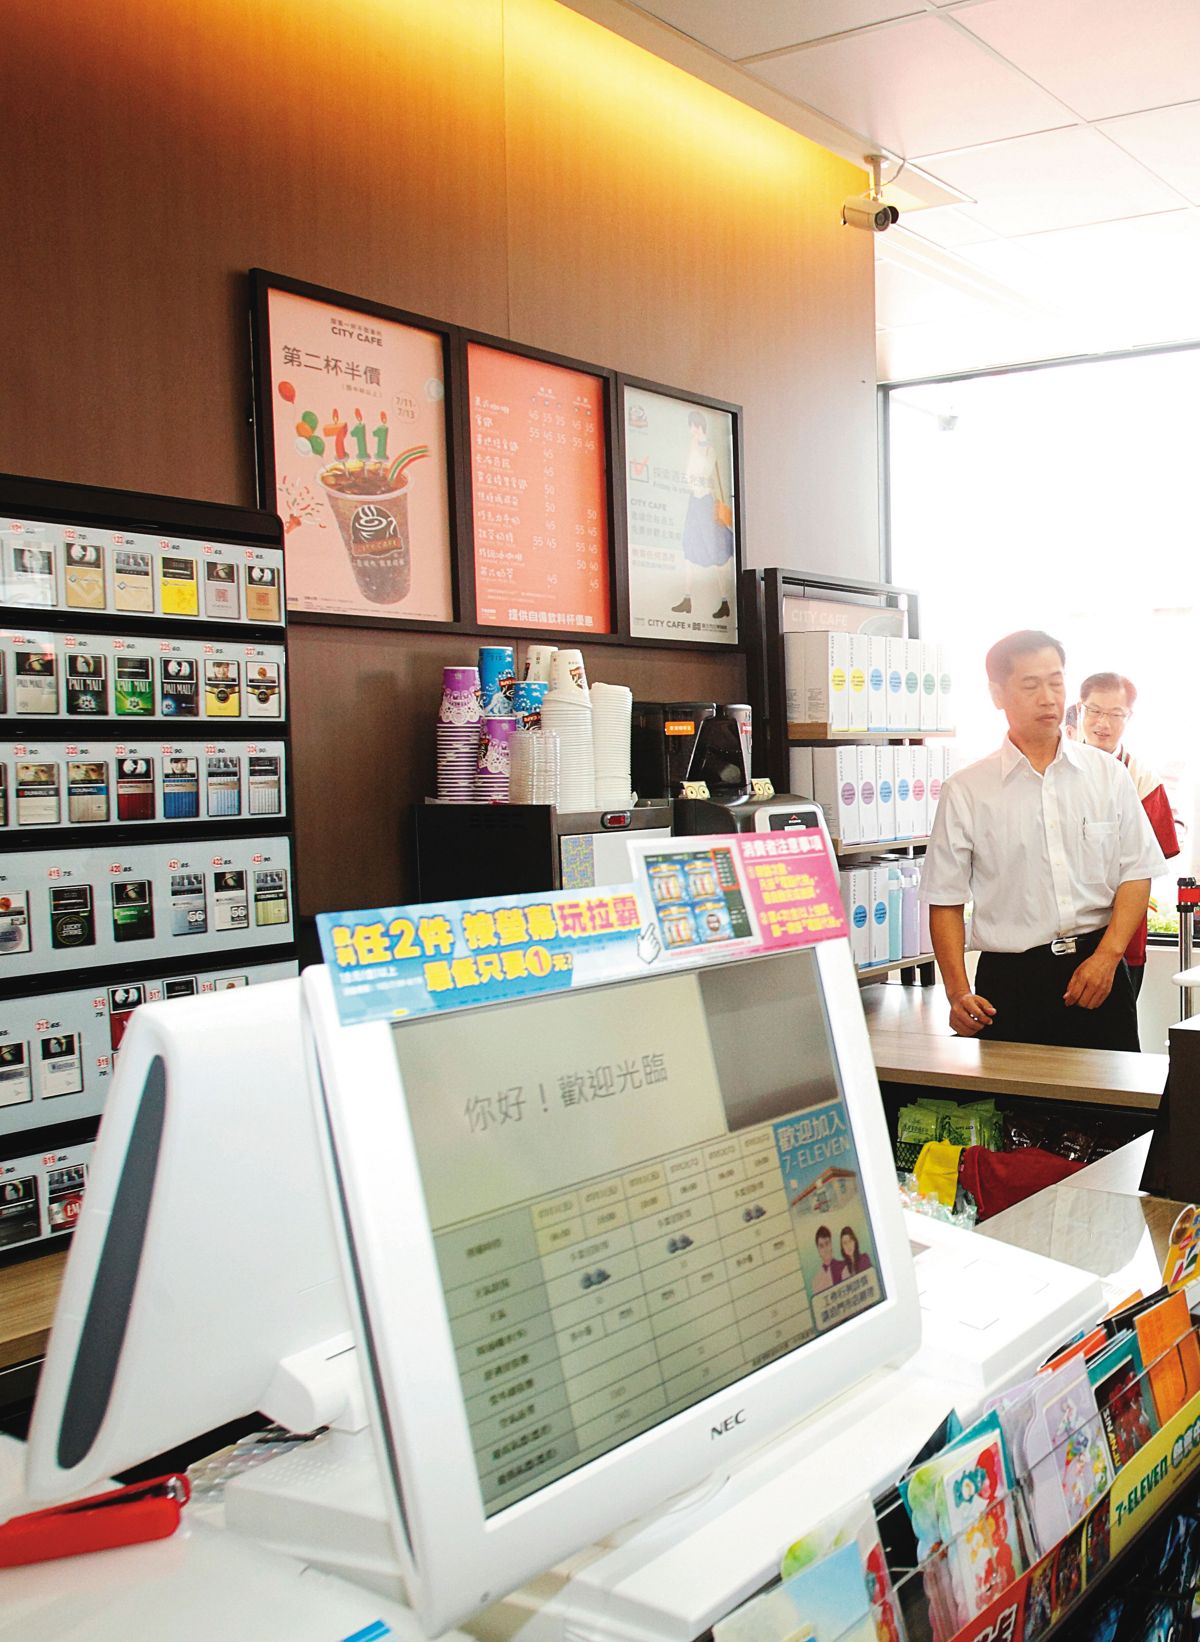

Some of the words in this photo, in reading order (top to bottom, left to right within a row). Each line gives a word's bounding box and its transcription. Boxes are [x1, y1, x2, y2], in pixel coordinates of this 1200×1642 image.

[331, 326, 354, 339] CITY
[357, 333, 383, 347] CAFE
[282, 345, 382, 387] 第二杯半價
[508, 608, 593, 627] 提供自備飲料杯優惠
[648, 619, 664, 628] CITY
[666, 621, 686, 630] CAFE
[68, 679, 84, 691] PALL
[86, 679, 102, 692] MALL
[117, 680, 132, 692] PALL
[134, 680, 149, 693] MALL
[163, 683, 178, 695] PALL
[178, 683, 193, 695] MALL
[741, 834, 824, 858] 消費者注意事項
[188, 910, 205, 922] 56
[230, 906, 246, 918] 56
[463, 1052, 668, 1133] 你好！歡迎光臨
[777, 1109, 847, 1152] 歡迎加入
[782, 1134, 851, 1174] 7-ELEVEN
[710, 1410, 746, 1440] NEC
[1115, 1455, 1168, 1526] 7-ELEVEN
